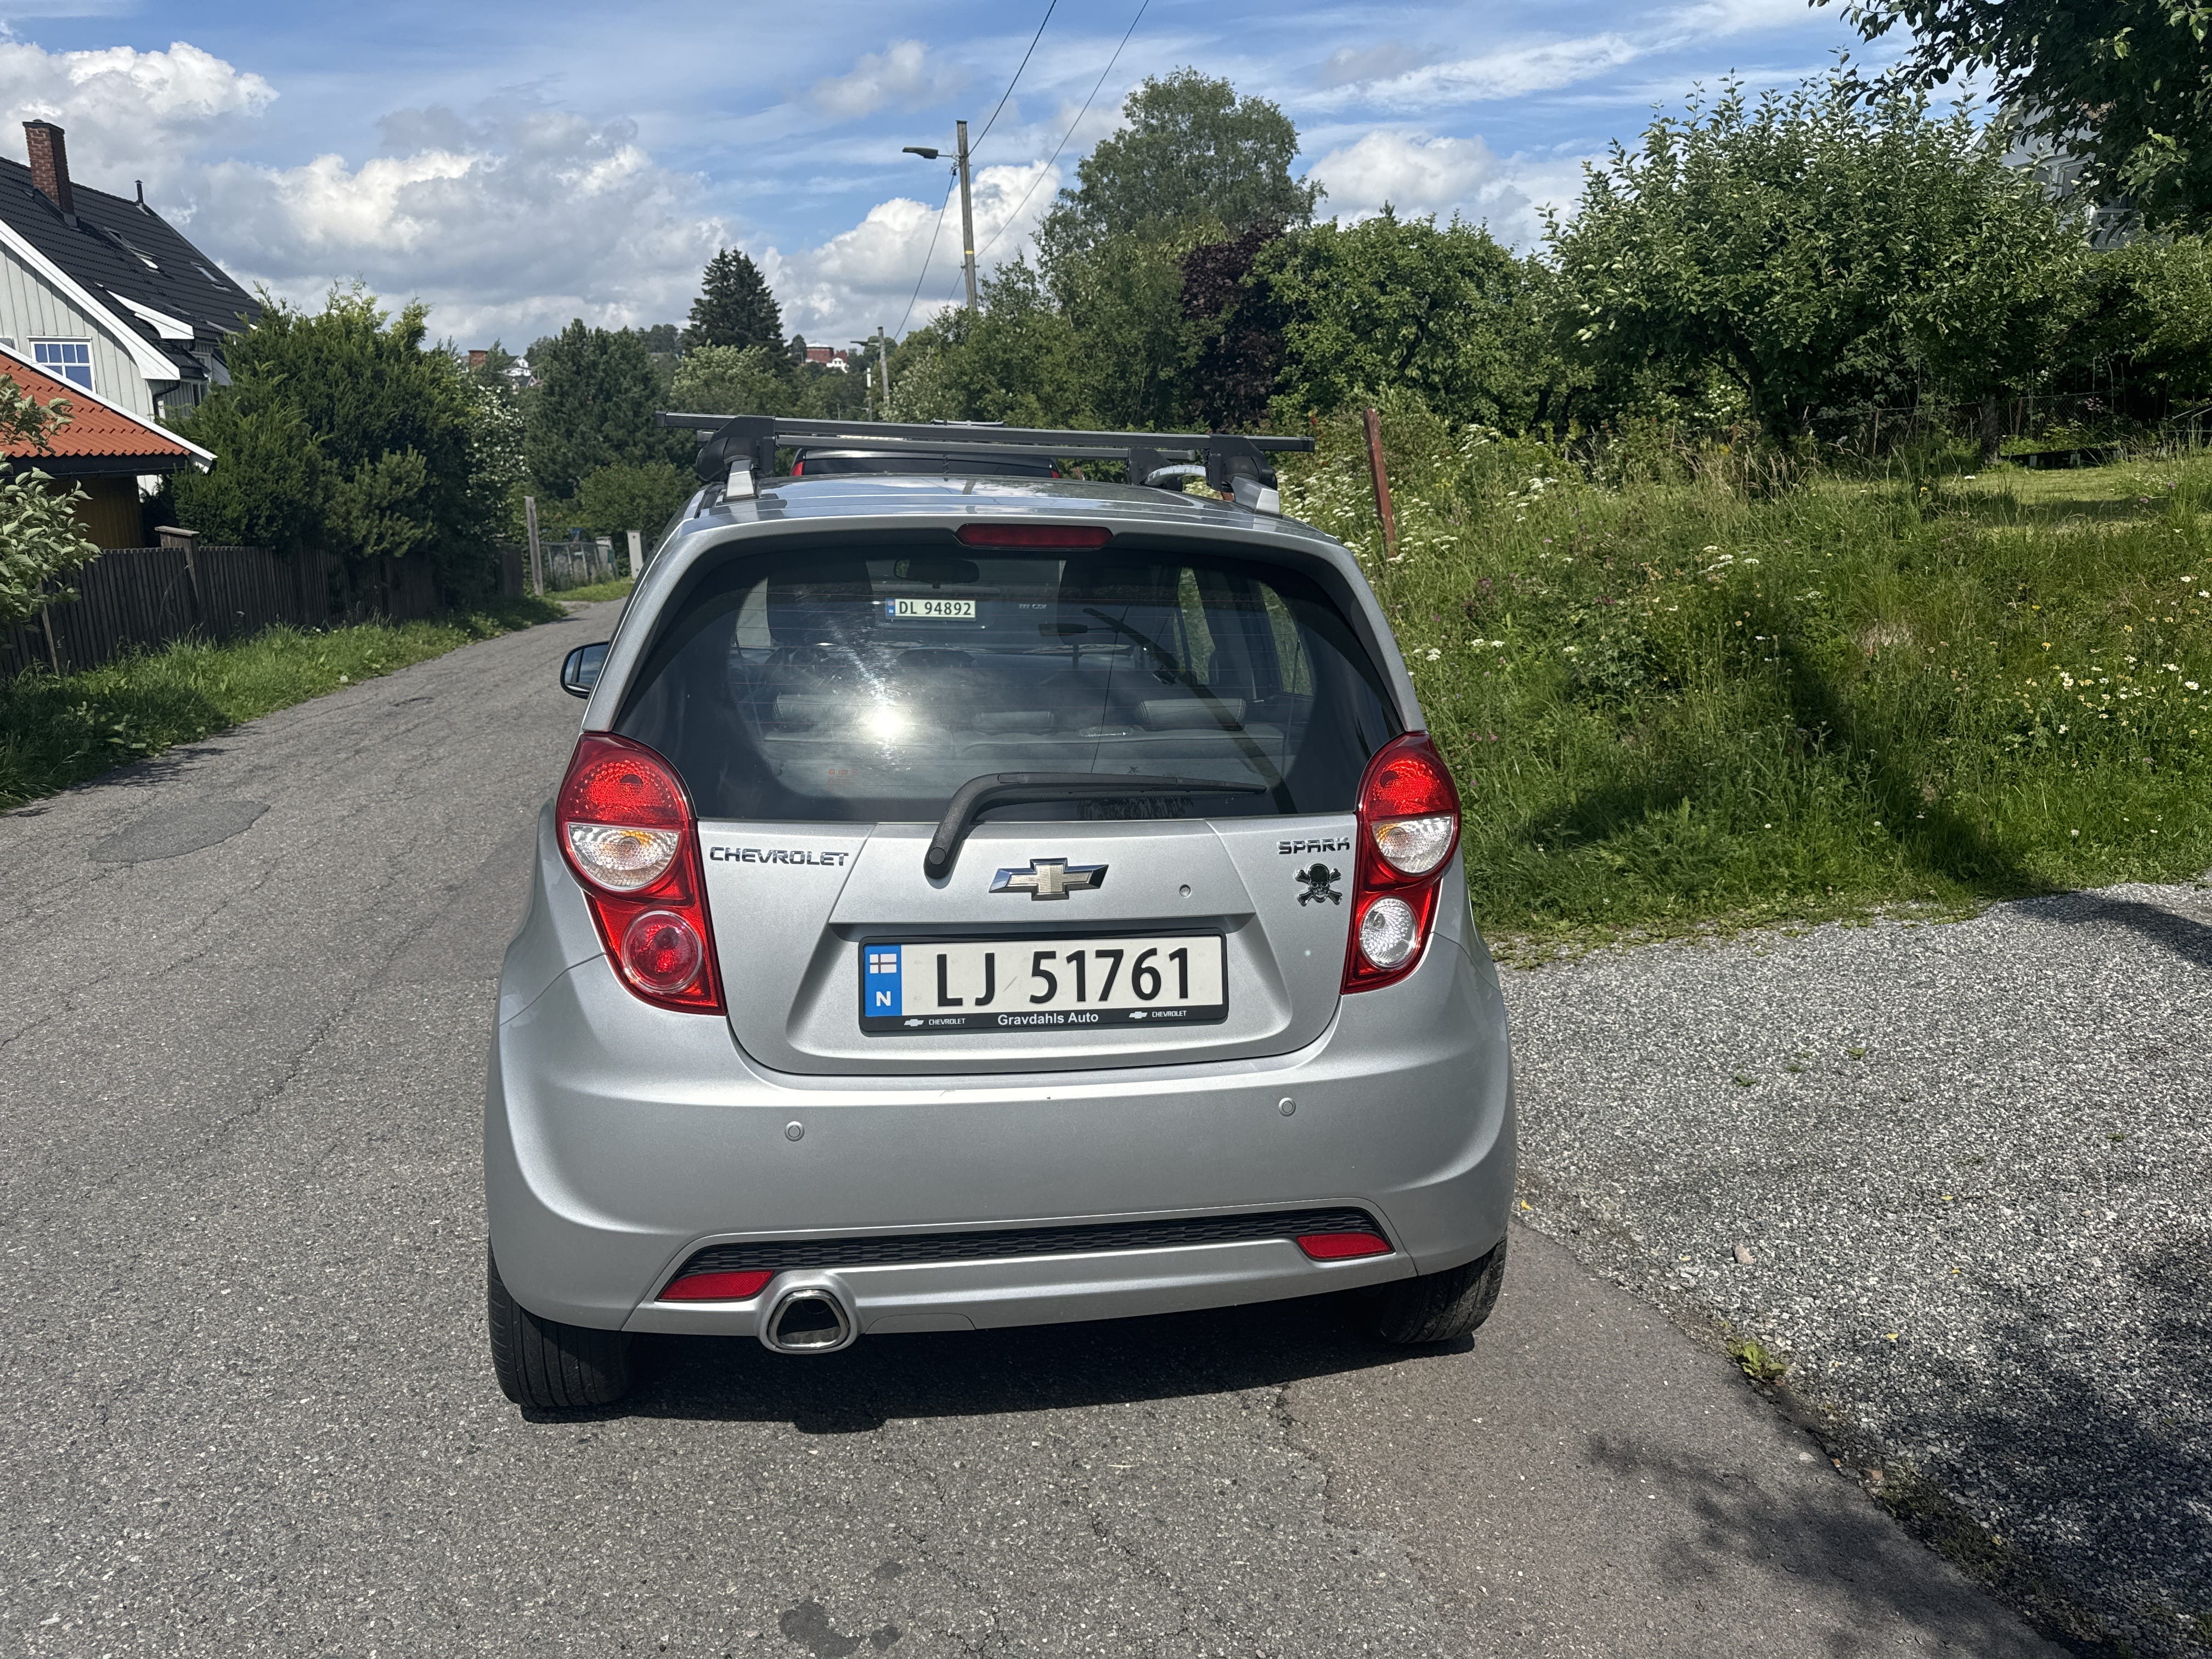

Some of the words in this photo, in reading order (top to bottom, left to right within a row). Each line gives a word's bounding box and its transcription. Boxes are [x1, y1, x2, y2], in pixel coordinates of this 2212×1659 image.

[899, 601, 917, 614] DL
[924, 602, 972, 616] 94892
[1277, 837, 1350, 855] SPARK
[710, 847, 849, 866] CHEVROLET
[936, 952, 995, 1007] LJ
[1029, 947, 1189, 1004] 51761
[876, 991, 891, 1006] N
[997, 1013, 1064, 1025] Gravdahls
[1068, 1012, 1099, 1023] Auto
[1152, 1010, 1187, 1018] CHEVROLET
